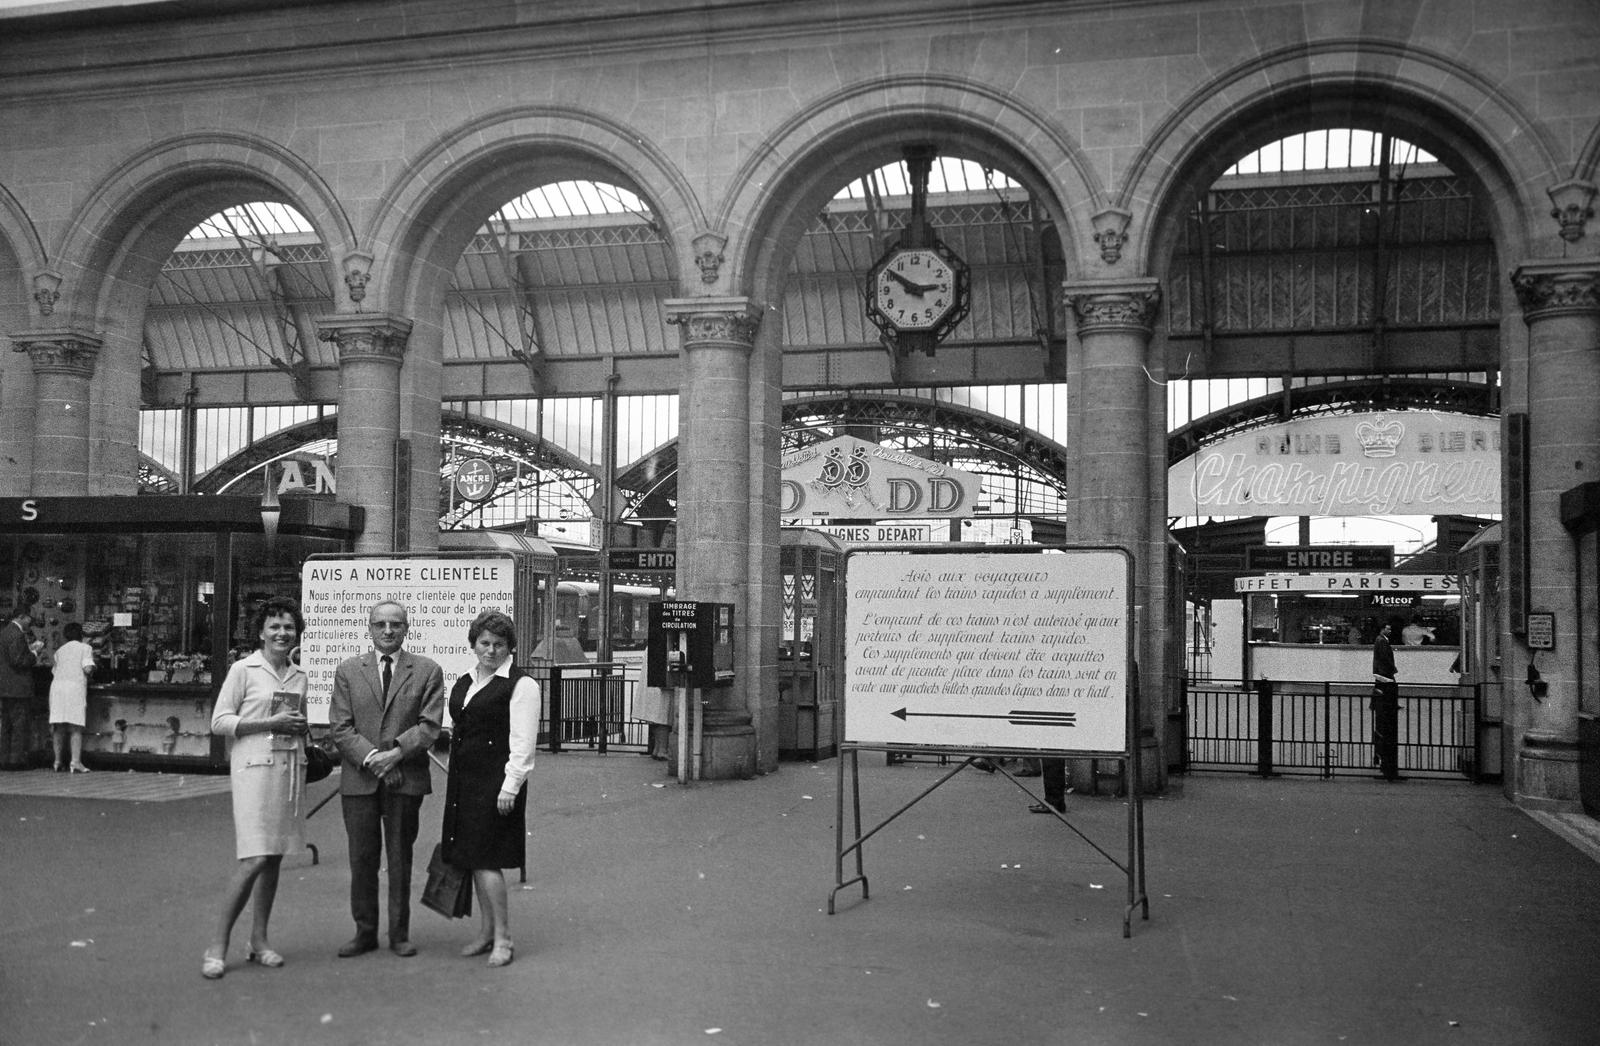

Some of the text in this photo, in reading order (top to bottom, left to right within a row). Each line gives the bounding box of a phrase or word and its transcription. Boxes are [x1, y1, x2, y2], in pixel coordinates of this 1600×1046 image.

[897, 262, 904, 271] 11
[910, 256, 920, 265] 12
[935, 269, 943, 278] 2
[883, 286, 890, 295] 9
[940, 283, 947, 293] 3
[887, 298, 894, 309] 8
[934, 299, 942, 308] 4
[898, 310, 905, 319] 7
[911, 312, 918, 322] 6
[925, 308, 933, 318] 5
[459, 475, 490, 483] ANCRE
[21, 500, 38, 521] S
[878, 527, 924, 541] DÉPART
[1287, 550, 1353, 567] ENTRÉE
[311, 568, 343, 581] AVIS
[350, 568, 359, 581] A
[366, 568, 412, 581] NOTRE
[938, 572, 967, 582] aux
[974, 572, 1049, 586] voyageurs
[309, 589, 330, 600] Nous
[333, 589, 382, 603] informons
[386, 590, 412, 600] notre
[460, 592, 475, 604] que
[855, 587, 920, 603] empruntant
[944, 586, 977, 599] trains
[981, 586, 1026, 604] rapides
[341, 604, 356, 614] des
[419, 604, 428, 614] la
[431, 606, 451, 614] cour
[454, 604, 465, 614] de
[468, 604, 477, 614] la
[927, 613, 942, 626] de
[946, 616, 963, 626] ces
[966, 613, 1000, 626] trains
[1003, 613, 1030, 627] n'est
[855, 630, 902, 646] porteurs
[907, 630, 921, 643] de
[1000, 631, 1035, 643] trains
[309, 644, 321, 653] au
[325, 642, 361, 656] parking
[406, 644, 426, 654] taux
[956, 647, 975, 664] qui
[979, 648, 1021, 661] doivent
[1025, 648, 1046, 661] être
[308, 670, 319, 679] au
[855, 664, 888, 676] avant
[891, 664, 906, 677] de
[906, 665, 949, 680] prendre
[951, 665, 983, 681] place
[986, 666, 1014, 678] dans
[1075, 667, 1101, 680] sont
[1104, 670, 1117, 681] en
[851, 682, 877, 693] vente
[879, 683, 899, 693] aux
[900, 681, 940, 697] guichets
[941, 680, 969, 695] billets
[971, 682, 1011, 697] grandes
[1012, 682, 1043, 698] lignes
[1045, 683, 1070, 697] dans
[1073, 687, 1085, 698] ce
